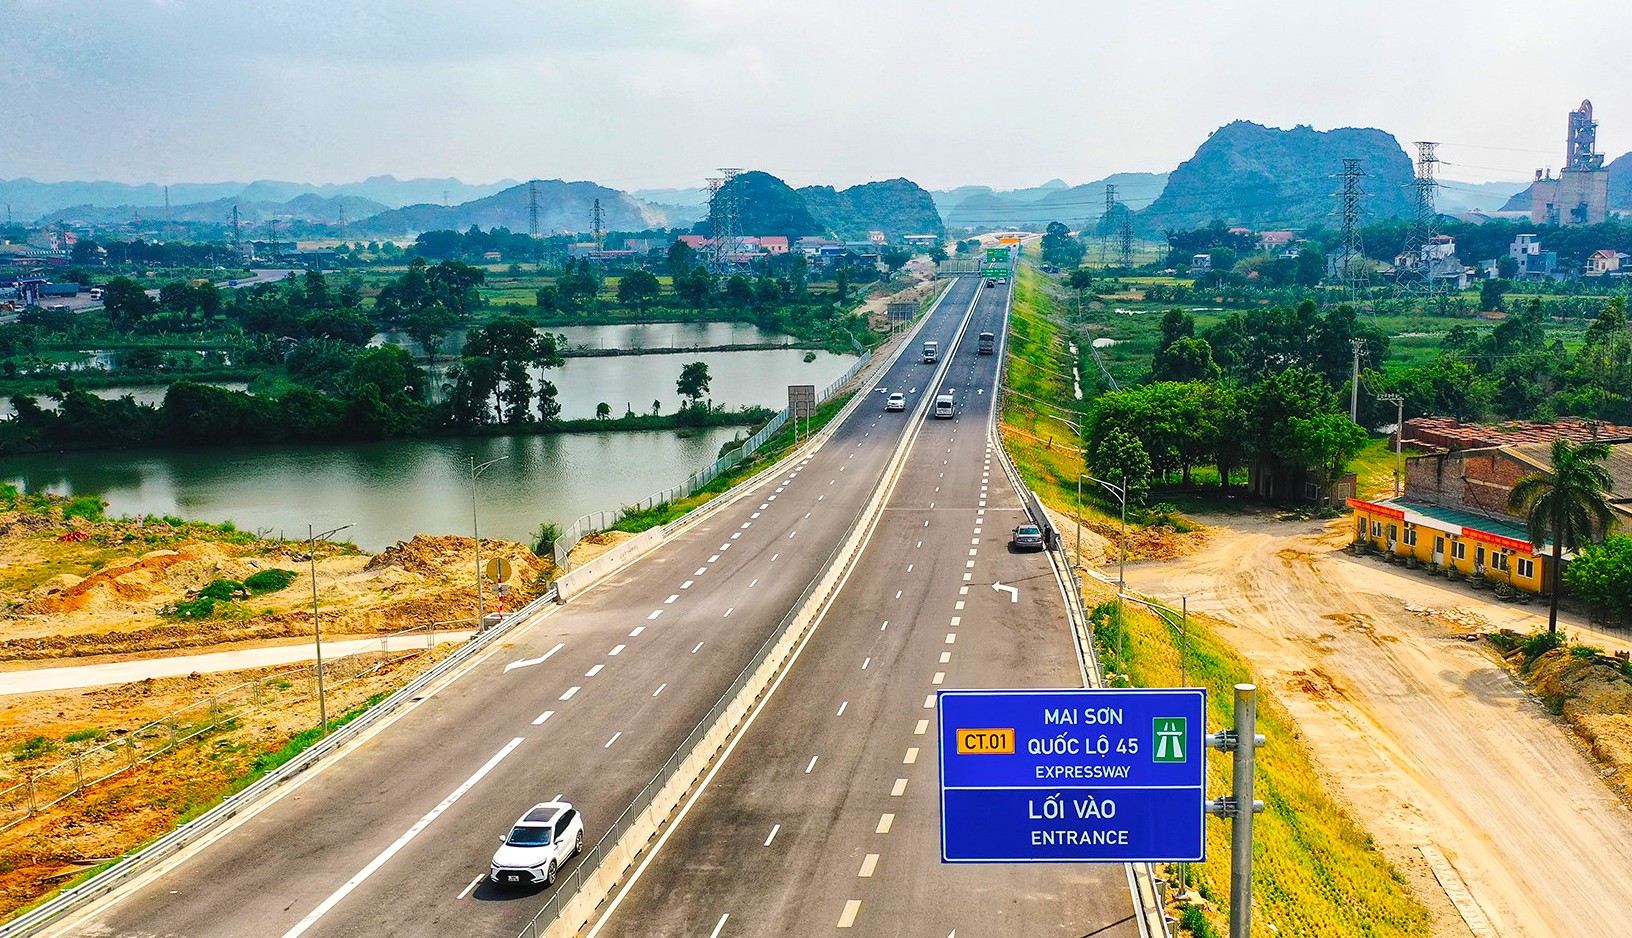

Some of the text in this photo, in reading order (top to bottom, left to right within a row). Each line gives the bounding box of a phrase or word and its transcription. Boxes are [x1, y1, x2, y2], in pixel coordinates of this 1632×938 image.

[1044, 706, 1123, 725] MAI SƠN
[965, 734, 1006, 750] CT.01
[1028, 732, 1139, 758] QUỐC LỘ 45
[1035, 765, 1131, 779] EXPRESSWAY
[1028, 793, 1116, 819] LỐI VÀO
[1031, 830, 1129, 846] ENTRANCE
